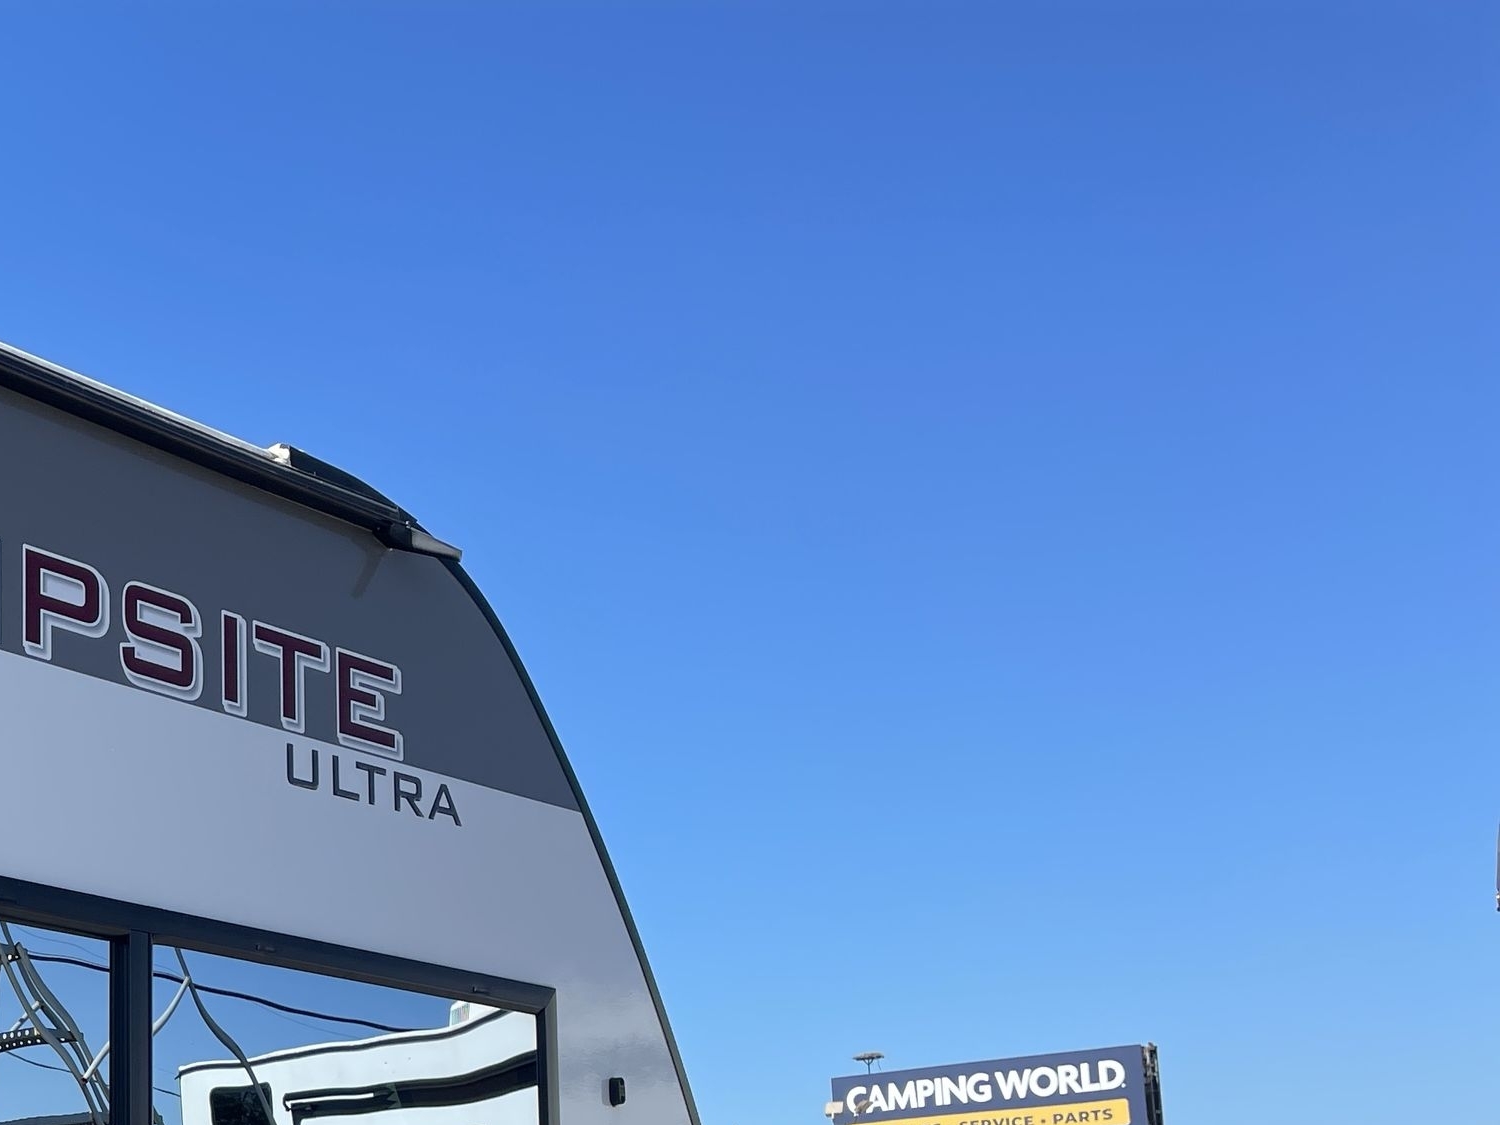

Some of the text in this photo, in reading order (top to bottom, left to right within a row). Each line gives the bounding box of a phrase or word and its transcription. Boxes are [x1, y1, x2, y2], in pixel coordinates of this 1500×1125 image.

[285, 742, 462, 828] ULTRA
[846, 1071, 993, 1114] CAMPING
[1053, 1108, 1114, 1125] PARTS
